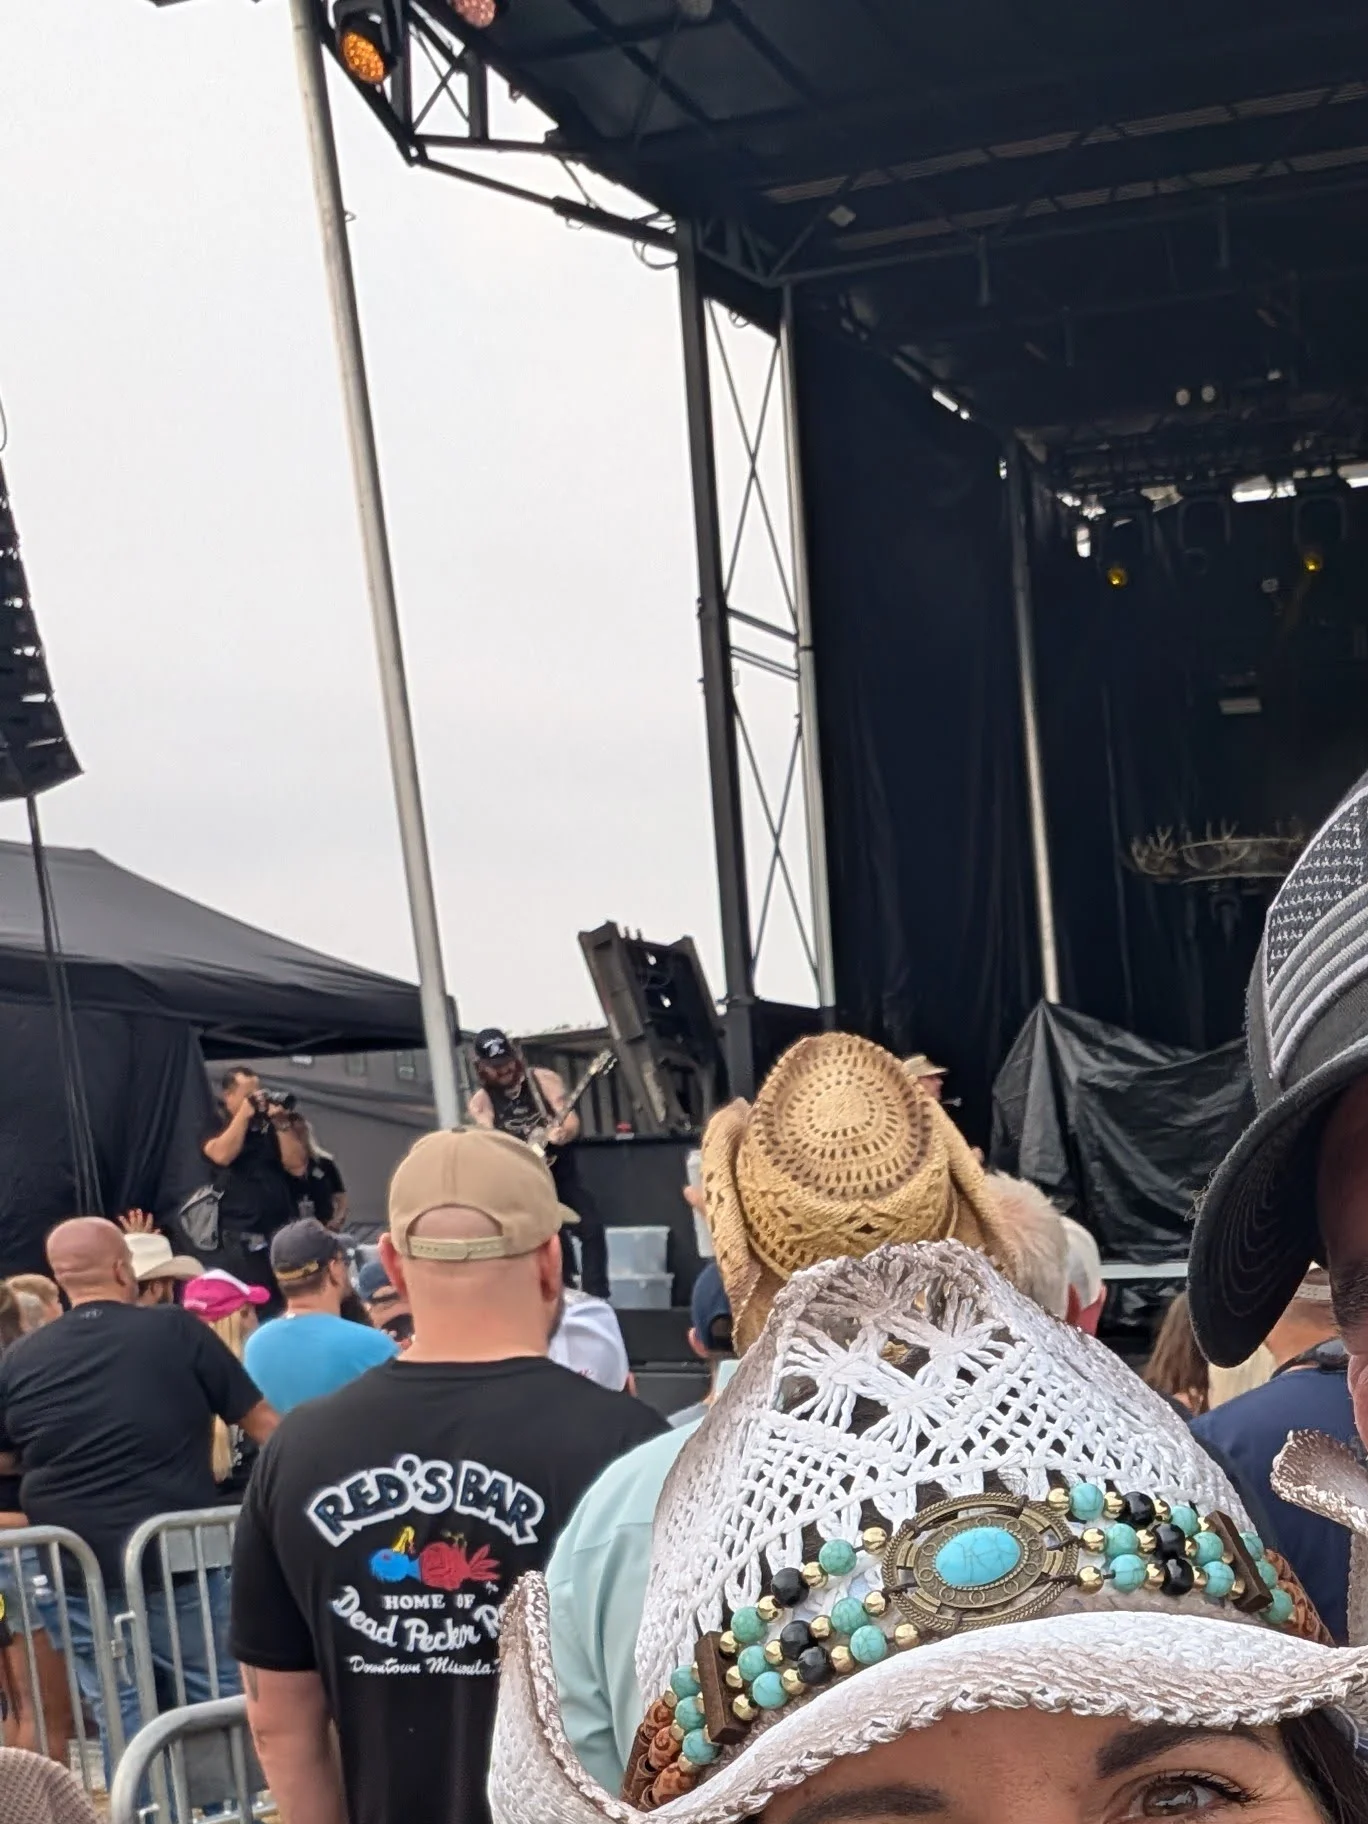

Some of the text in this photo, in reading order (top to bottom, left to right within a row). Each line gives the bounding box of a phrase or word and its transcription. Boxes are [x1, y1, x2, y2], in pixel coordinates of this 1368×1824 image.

[307, 1453, 545, 1547] RED'S BAR
[332, 1585, 398, 1648] Dead
[383, 1594, 476, 1610] HOME OF
